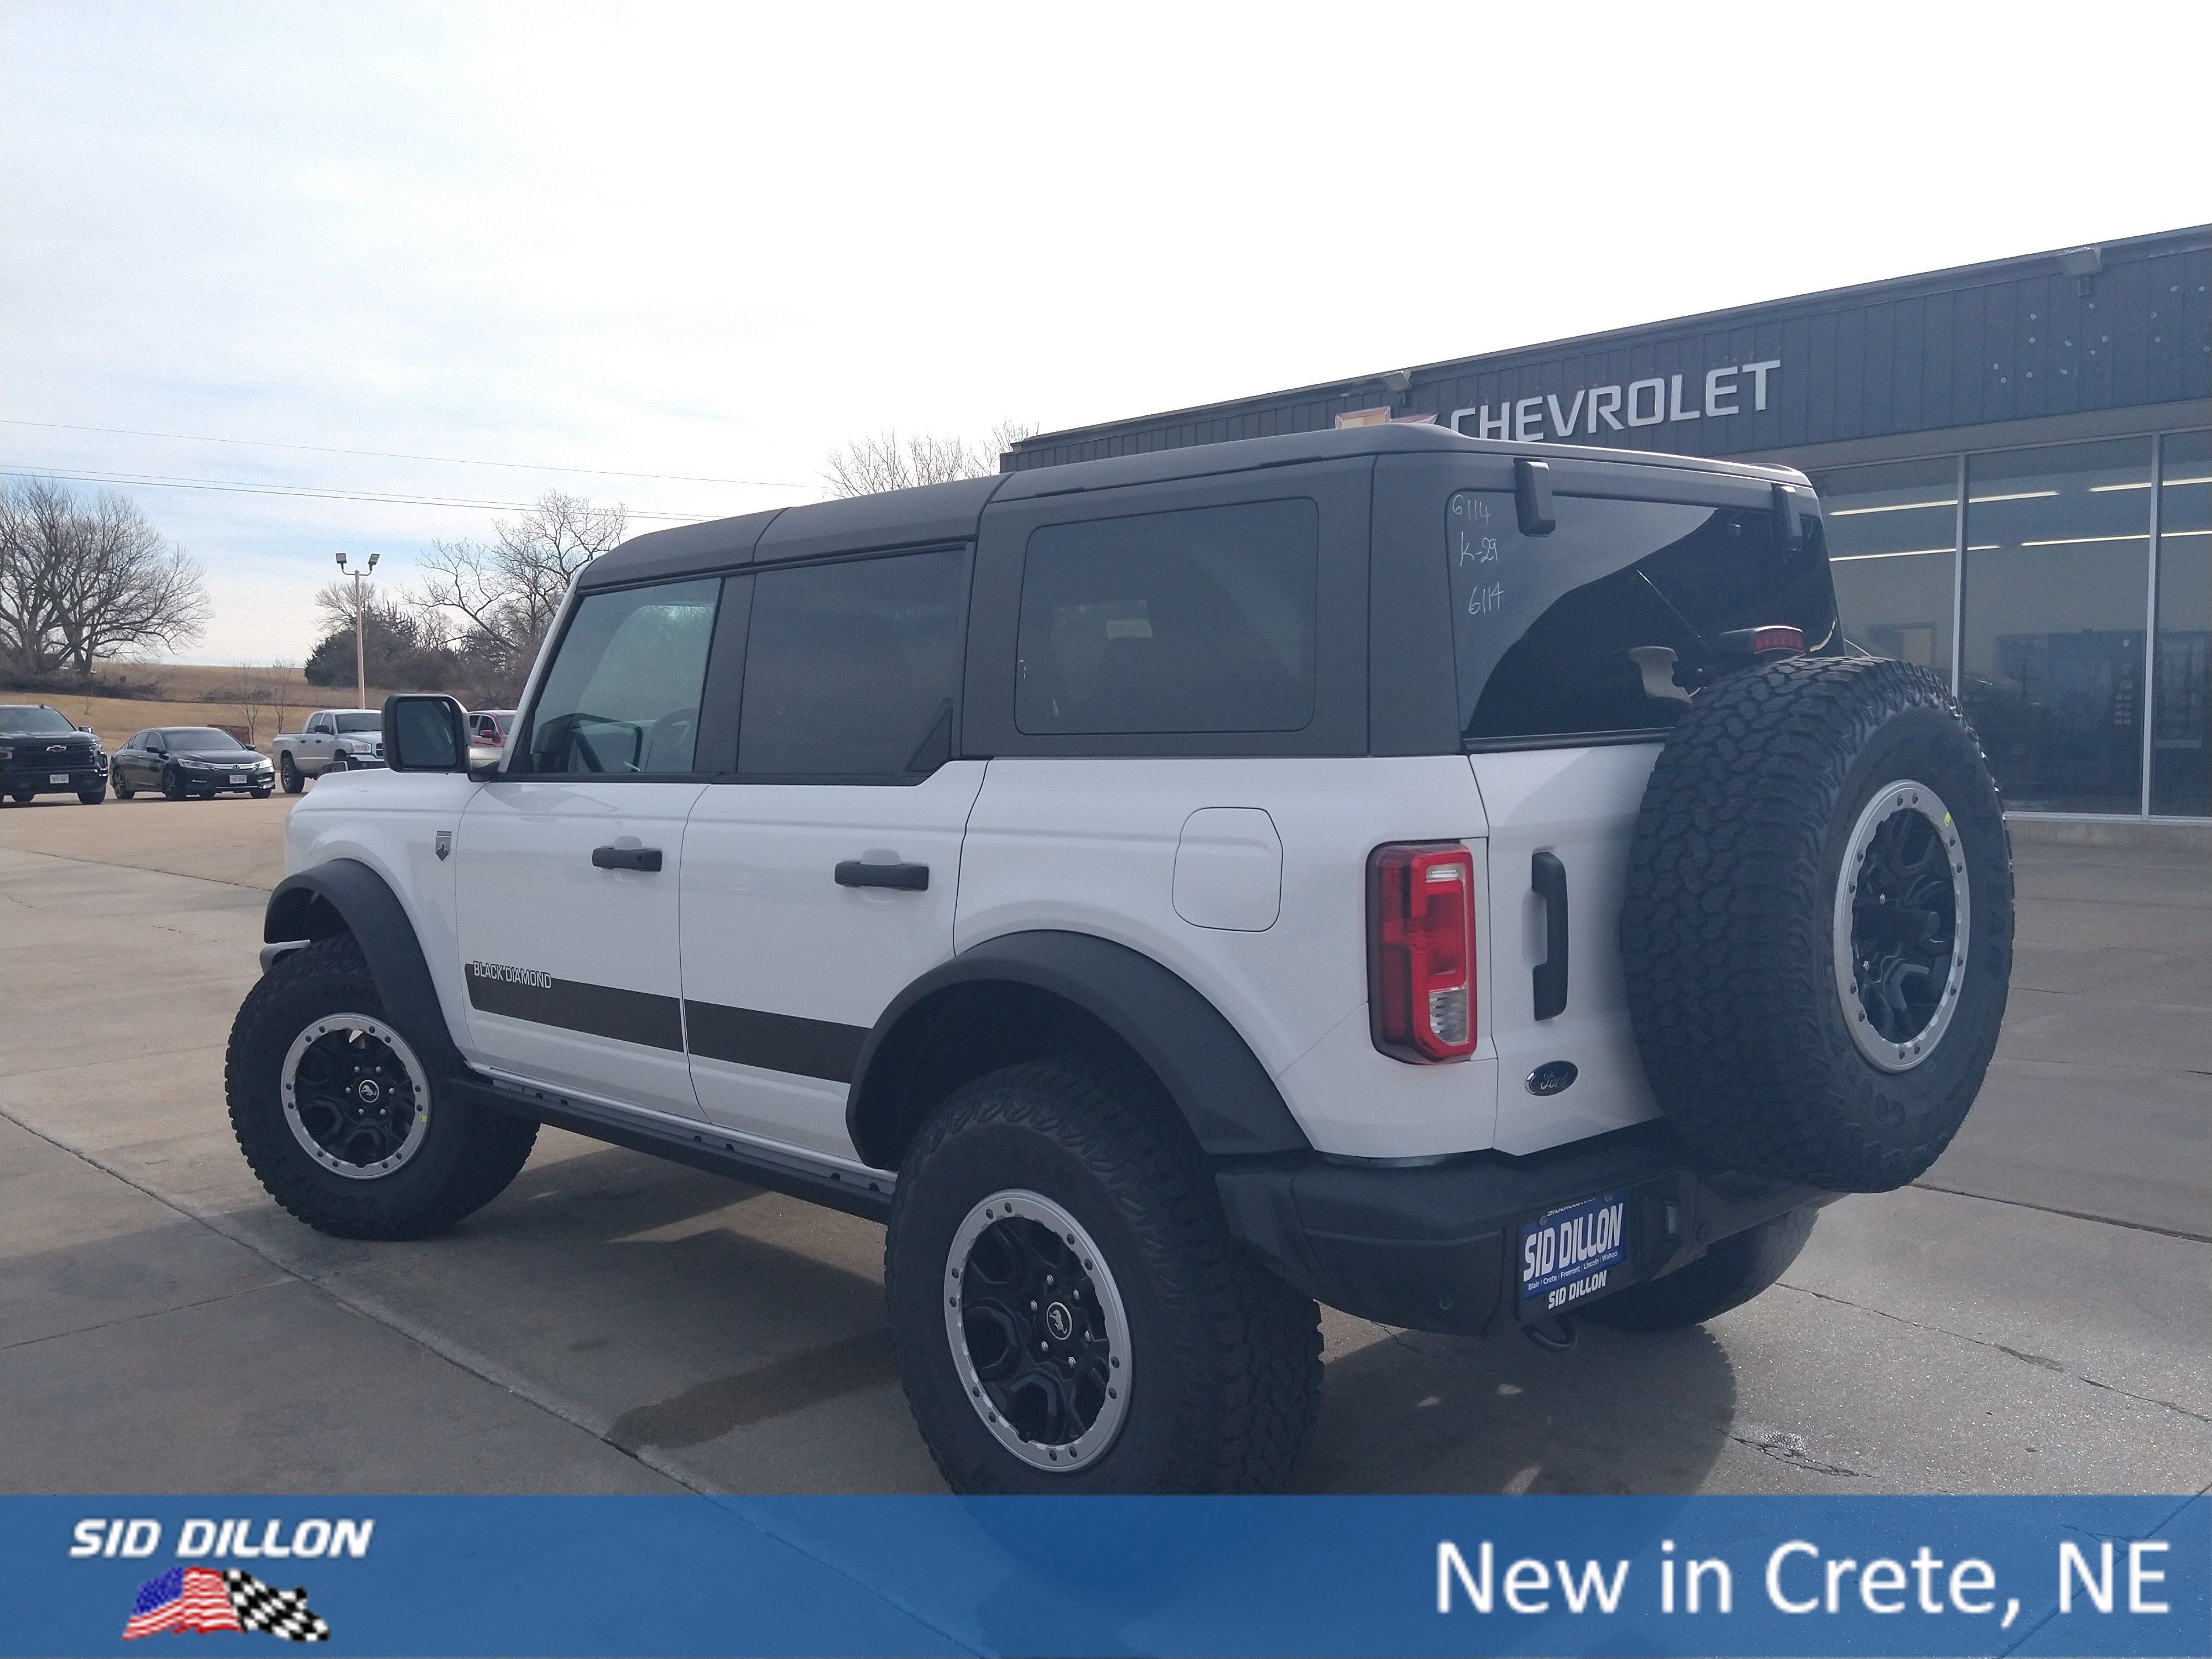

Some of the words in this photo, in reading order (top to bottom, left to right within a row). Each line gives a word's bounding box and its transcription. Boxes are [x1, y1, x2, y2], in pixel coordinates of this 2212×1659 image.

[1450, 359, 1781, 442] CHEVROLET
[1452, 494, 1491, 525] 6114
[1469, 582, 1504, 614] 6114
[473, 961, 504, 980] BLACK
[505, 966, 552, 989] DIAMOND
[1524, 1227, 1556, 1282] SID
[1559, 1202, 1624, 1269] DILLON
[1543, 1275, 1557, 1285] Crete
[1561, 1266, 1580, 1279] Fremont
[1583, 1258, 1599, 1270] Lincoln
[1548, 1287, 1566, 1310] SID
[1568, 1270, 1607, 1301] DILLON
